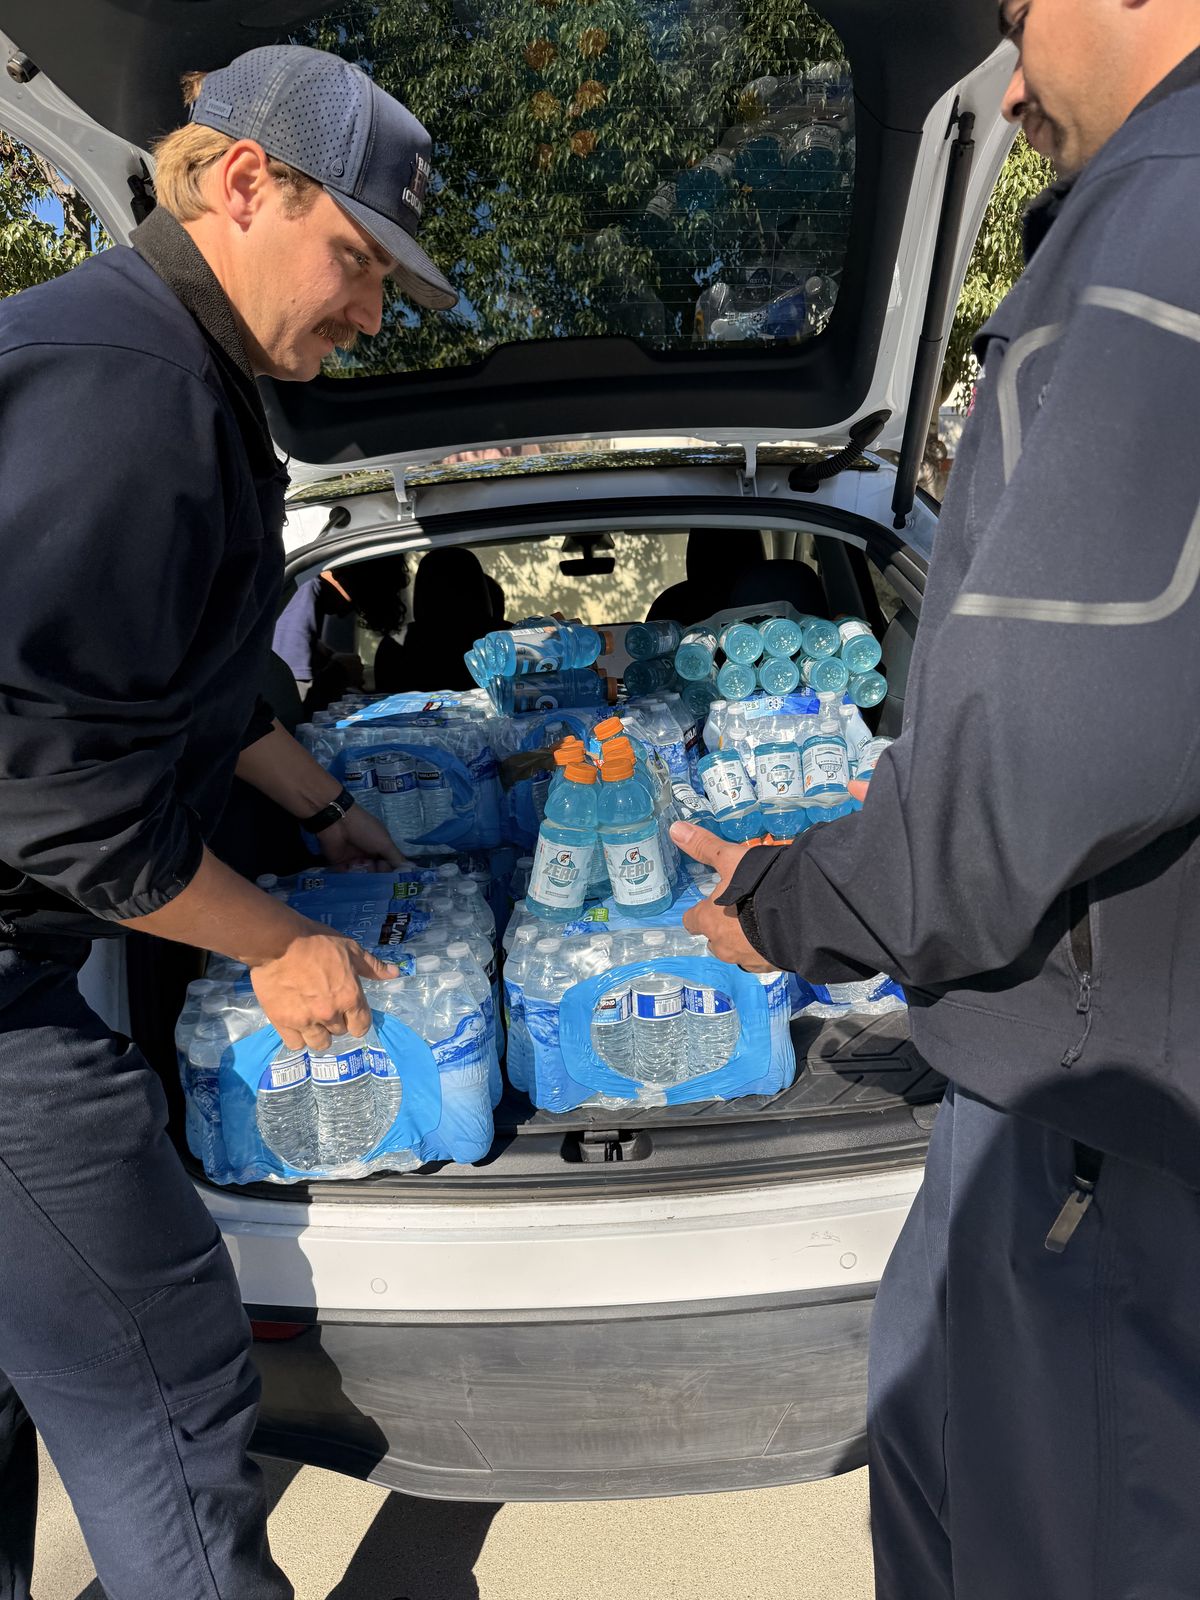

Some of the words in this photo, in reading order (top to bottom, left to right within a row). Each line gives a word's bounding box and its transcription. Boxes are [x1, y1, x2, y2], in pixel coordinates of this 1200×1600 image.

[715, 776, 744, 793] ZEO
[542, 862, 580, 881] ZERO
[619, 859, 655, 878] ZERO
